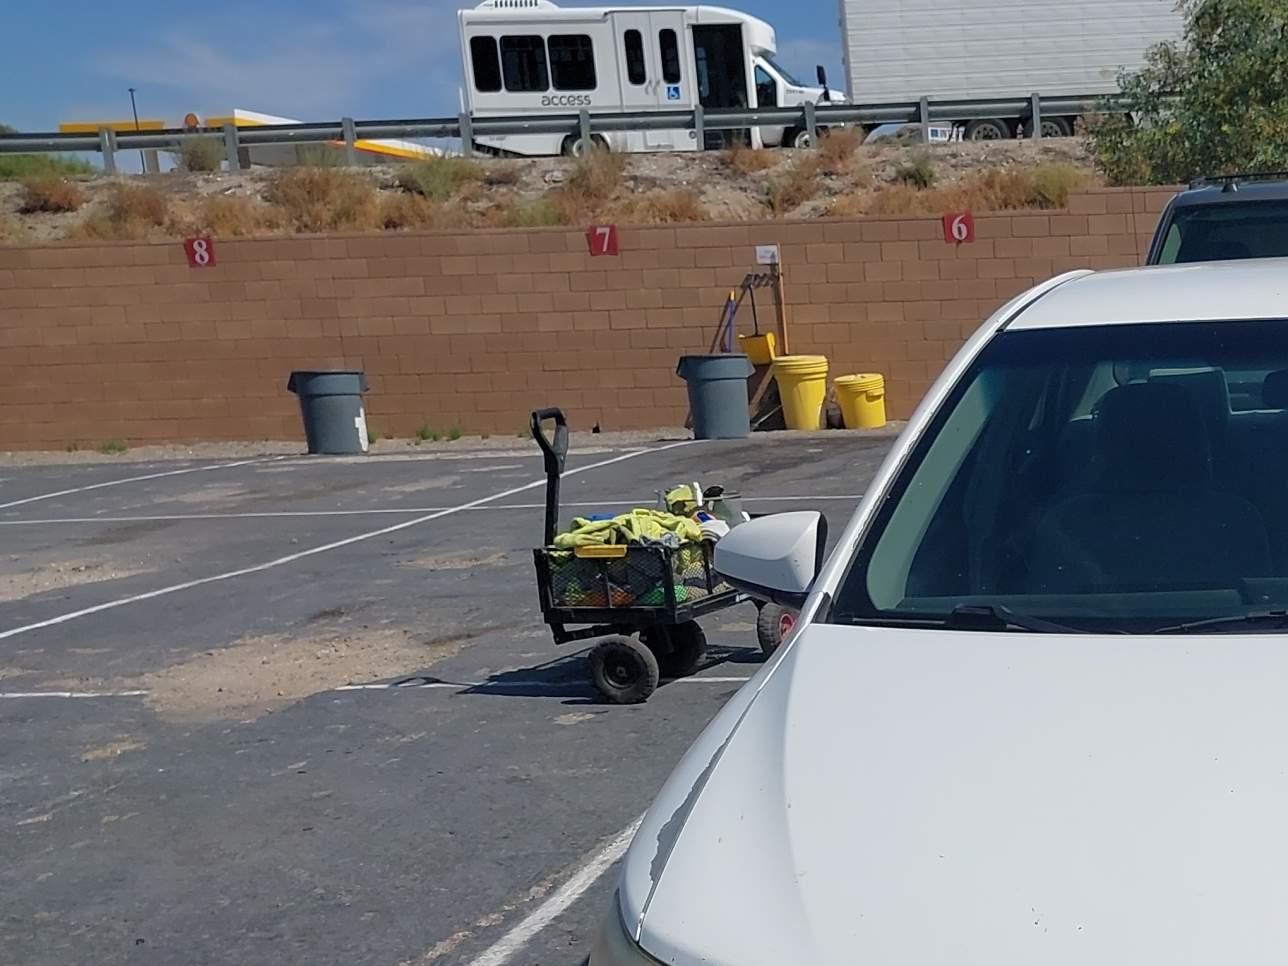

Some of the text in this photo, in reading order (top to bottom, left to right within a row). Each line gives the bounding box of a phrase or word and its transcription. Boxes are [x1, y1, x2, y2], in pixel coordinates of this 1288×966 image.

[541, 95, 592, 106] access
[595, 226, 611, 252] 7
[951, 214, 968, 241] 6
[192, 239, 210, 265] 8
